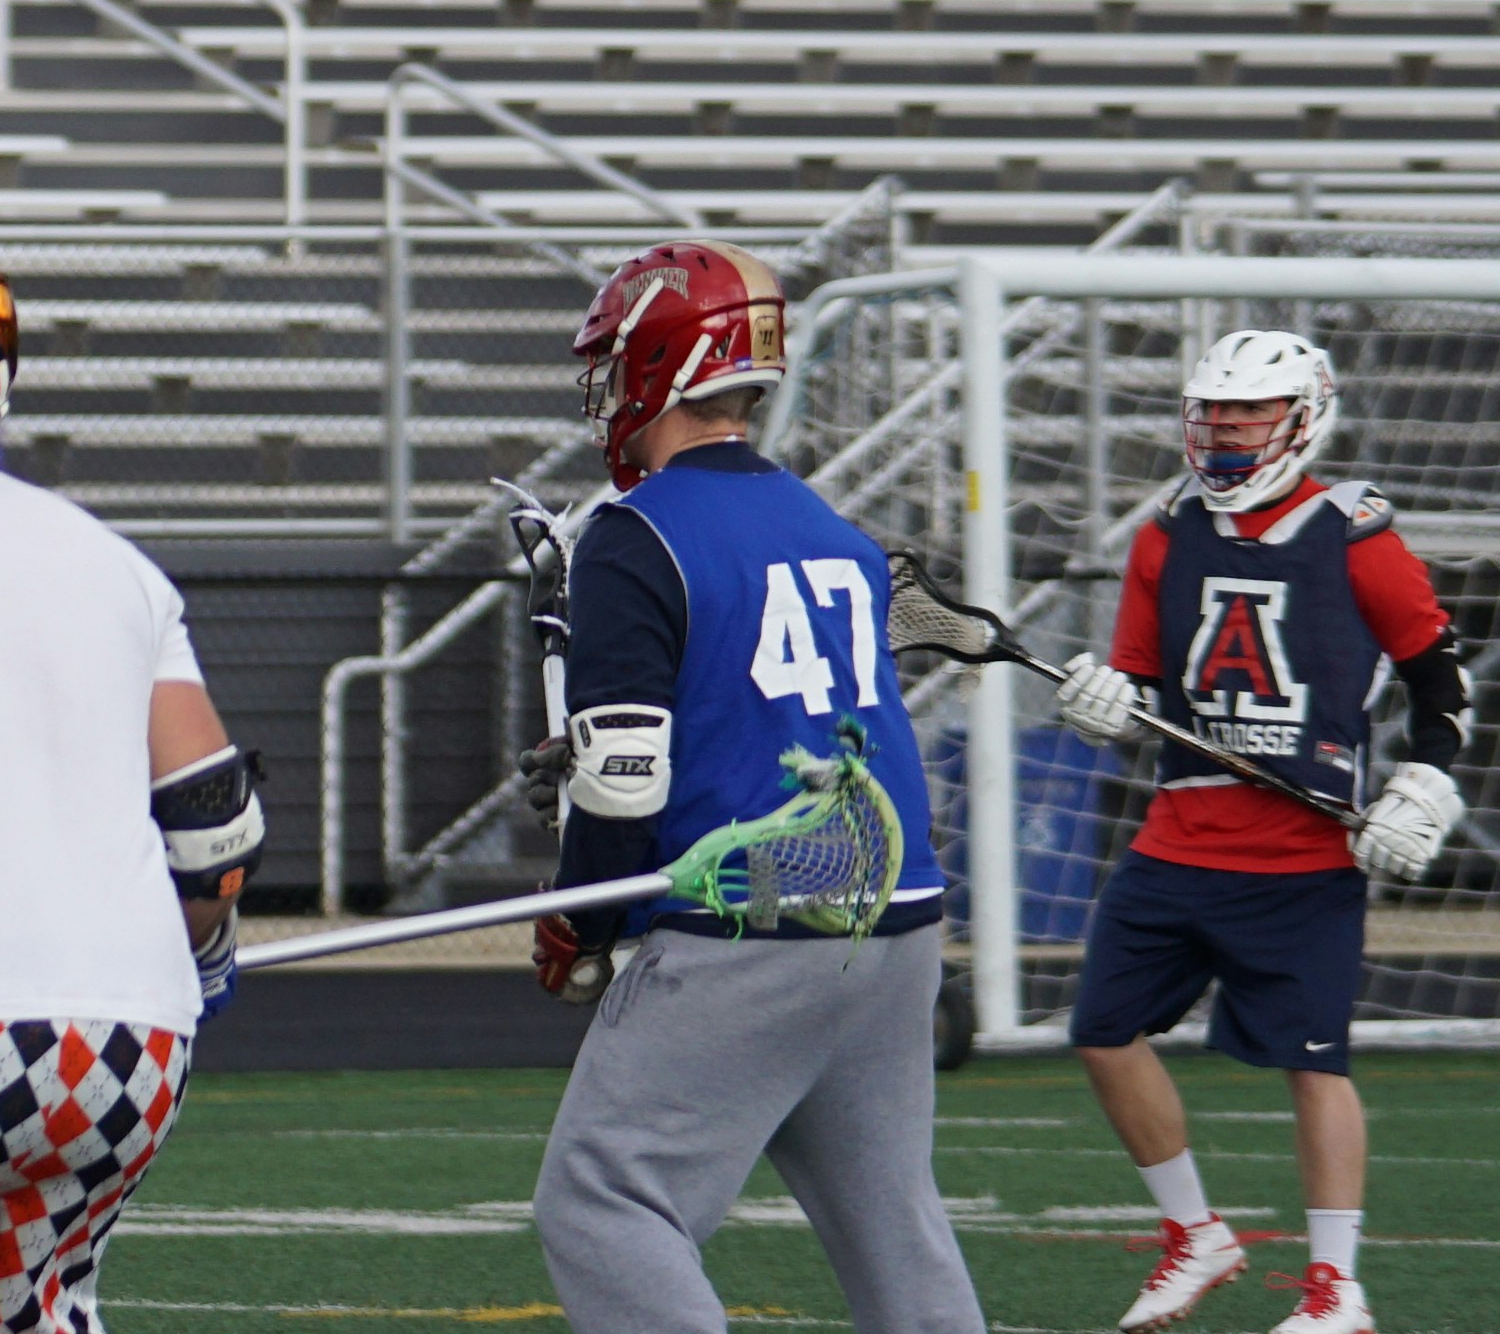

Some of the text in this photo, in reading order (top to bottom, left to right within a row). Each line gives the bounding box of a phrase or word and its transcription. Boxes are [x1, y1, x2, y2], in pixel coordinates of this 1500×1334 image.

[750, 558, 880, 715] 47
[1182, 576, 1310, 722] A
[603, 757, 653, 774] STX
[211, 827, 249, 855] STX
